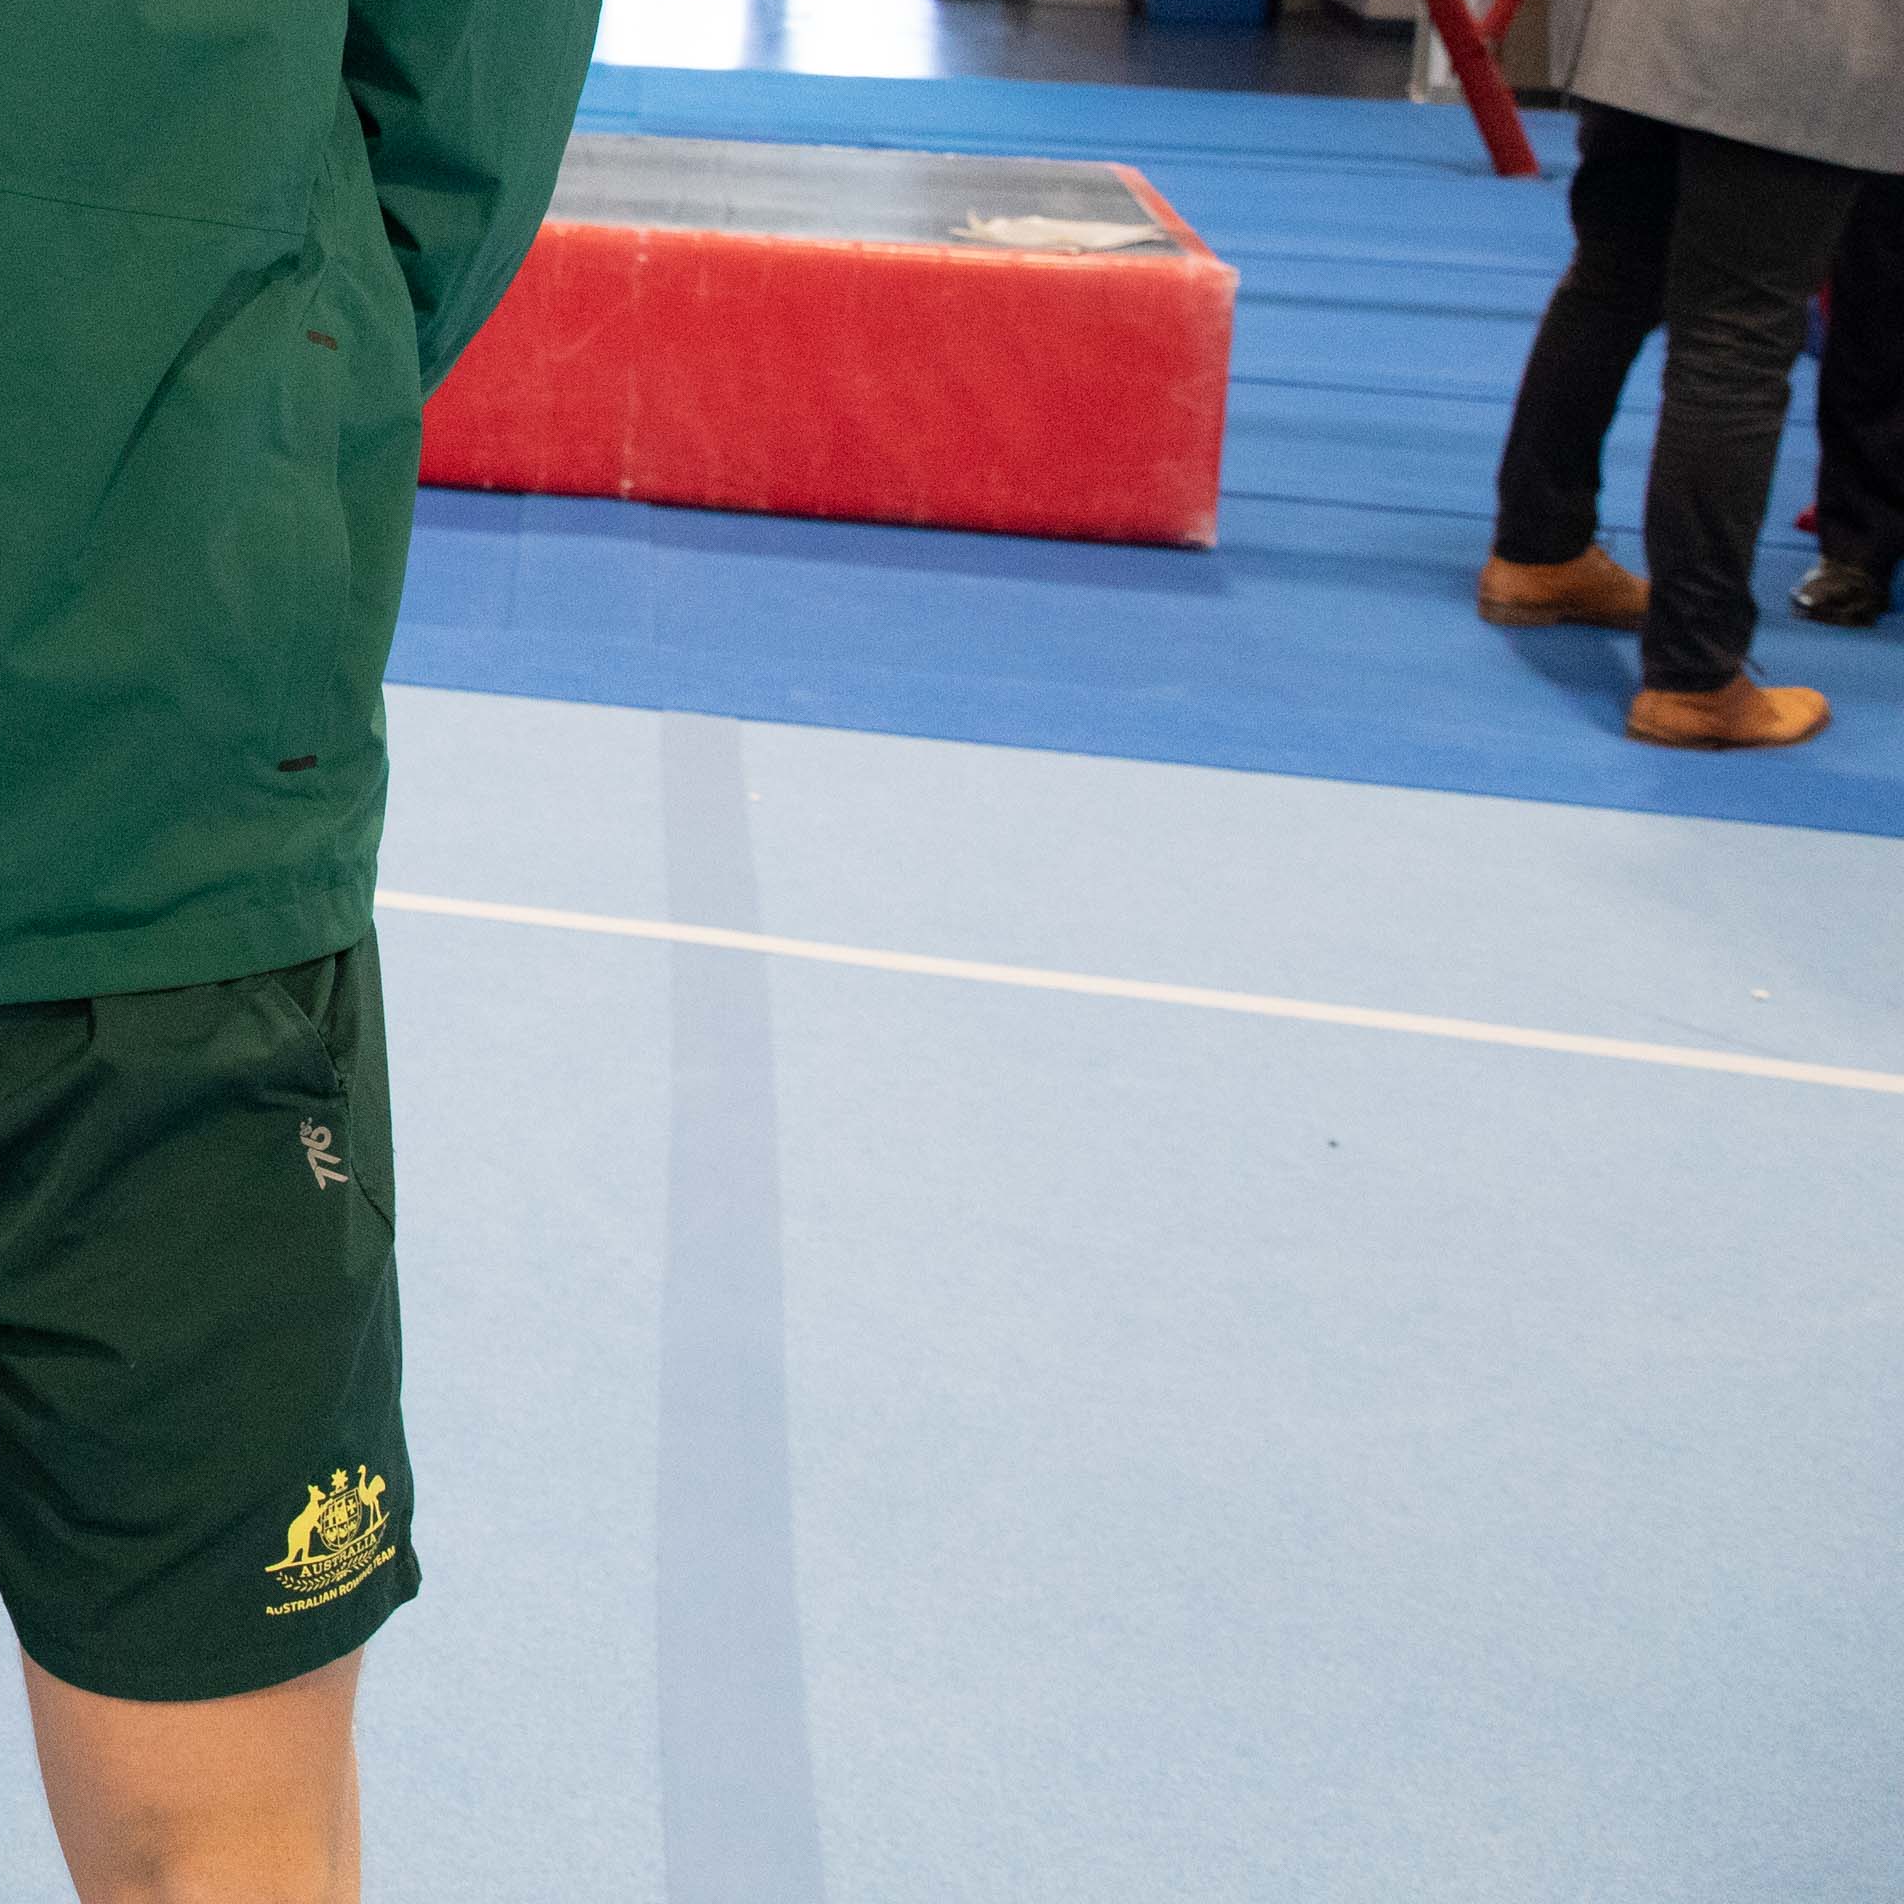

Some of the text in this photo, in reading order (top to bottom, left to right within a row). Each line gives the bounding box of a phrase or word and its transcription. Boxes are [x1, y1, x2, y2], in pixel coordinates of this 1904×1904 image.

[265, 1546, 396, 1615] AUSTRALIAN ROWING TEAM
[300, 1533, 378, 1578] AUSTRALIA
